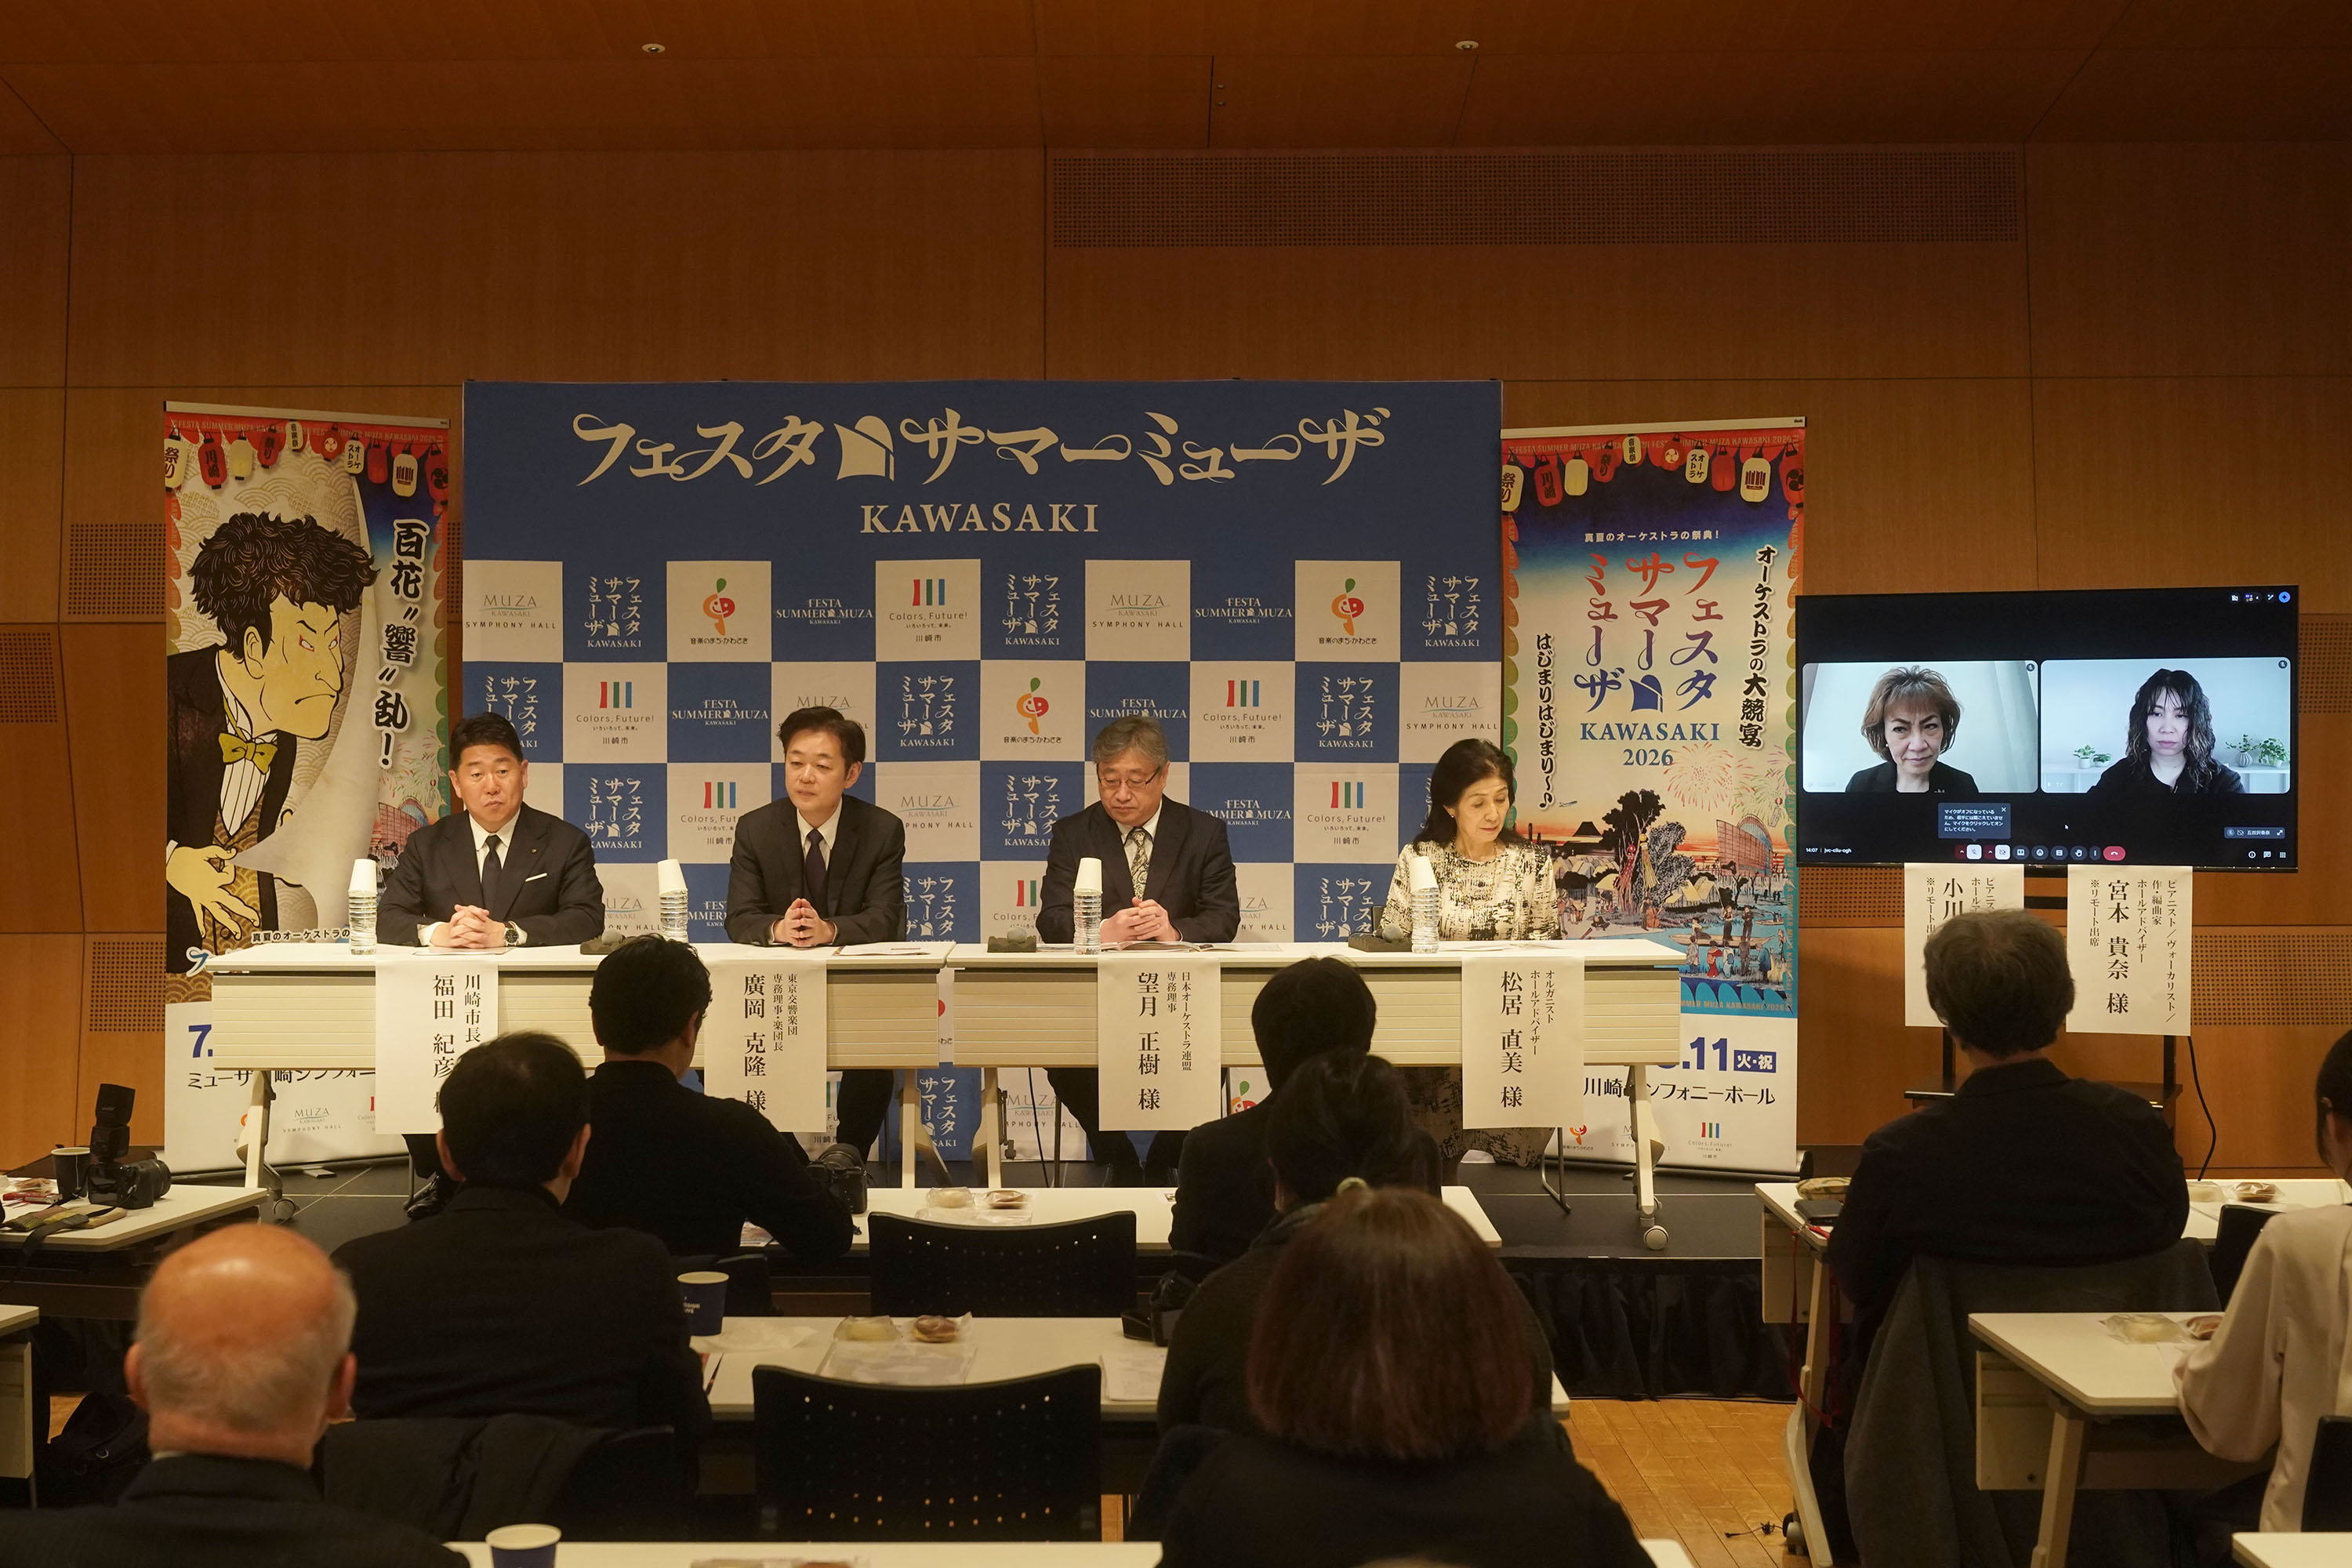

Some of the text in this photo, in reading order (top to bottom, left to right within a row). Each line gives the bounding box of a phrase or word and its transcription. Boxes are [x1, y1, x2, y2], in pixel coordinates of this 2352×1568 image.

[165, 447, 180, 478] 祭り
[573, 407, 1391, 487] フェスタ サマーミューザ
[1732, 436, 1770, 445] KAWASAKI
[1697, 453, 1705, 478] オーケ
[860, 503, 1099, 533] KAWASAKI
[484, 594, 537, 608] MUZA
[584, 576, 605, 637] ミューザ
[604, 576, 624, 622] サマー
[622, 576, 643, 637] フェスタ
[776, 608, 873, 618] SUMMER MUZA
[807, 598, 842, 608] FESTA
[889, 612, 967, 622] Colors, Future!
[1002, 574, 1023, 634] ミューザ
[1022, 574, 1042, 619] サマー
[1040, 574, 1061, 634] フェスタ
[1110, 593, 1164, 607] MUZA
[1195, 608, 1292, 618] SUMMER MUZA
[1225, 597, 1261, 607] FESTA
[1422, 575, 1443, 636] ミューザ
[1442, 575, 1462, 620] サマー
[1461, 575, 1481, 635] フェスタ
[1626, 552, 1675, 672] サマー
[587, 639, 642, 648] KAWASAKI
[1574, 554, 1625, 713] ミューザ
[1670, 552, 1724, 712] フェスタ
[672, 710, 768, 719] SUMMER MUZA
[703, 699, 738, 708] FESTA
[797, 696, 850, 707] MUZA
[898, 676, 917, 736] ミューザ
[918, 676, 937, 719] サマー
[935, 676, 956, 735] フェスタ
[1090, 709, 1187, 718] SUMMER MUZA
[1120, 699, 1156, 708] FESTA
[1203, 713, 1240, 722] Colors,
[1317, 677, 1336, 736] ミューザ
[1337, 677, 1356, 721] サマー
[1354, 677, 1375, 735] フェスタ
[1425, 696, 1479, 708] MUZA
[1580, 723, 1720, 741] KAWASAKI
[1623, 748, 1674, 766] 2026
[585, 777, 604, 837] ミューザ
[605, 778, 623, 822] サマー
[622, 778, 643, 837] フェスタ
[681, 815, 717, 823] Colors,
[902, 795, 954, 808] MUZA
[1002, 775, 1022, 835] ミューザ
[1022, 775, 1041, 819] サマー
[1225, 800, 1260, 808] FESTA
[1256, 811, 1291, 819] MUZA
[1308, 815, 1344, 823] Colors,
[1926, 877, 1936, 940] ※リモート出
[1943, 878, 1963, 920] 小川
[1972, 877, 1980, 911] ホールア
[1986, 877, 1994, 909] ピアニス
[2089, 879, 2100, 947] ※リモート出席
[2151, 880, 2162, 926] 作・編曲家
[2136, 879, 2147, 964] ホールアドバイザー
[2107, 880, 2129, 1014] 宮本 貴奈 様
[433, 975, 455, 1020] 福田
[464, 975, 481, 1043] 川崎市長
[787, 973, 798, 1036] 東京交響楽団
[1167, 971, 1177, 1013] 専務理事
[1530, 971, 1541, 1056] ホールアドバイザー
[1545, 970, 1555, 1024] オルガニスト
[744, 974, 767, 1112] 廣岡 克隆 様
[1137, 972, 1160, 1111] 望月 正樹 様
[1181, 971, 1192, 1071] 日本オーケストラ連盟
[1501, 971, 1523, 1108] 松居 直美 様
[1657, 1037, 1727, 1072] .11
[295, 1108, 329, 1118] MUZA
[920, 1077, 938, 1121] サマー
[938, 1076, 957, 1136] フェスタ
[1583, 1077, 1776, 1105] 川崎ンフォニーホール
